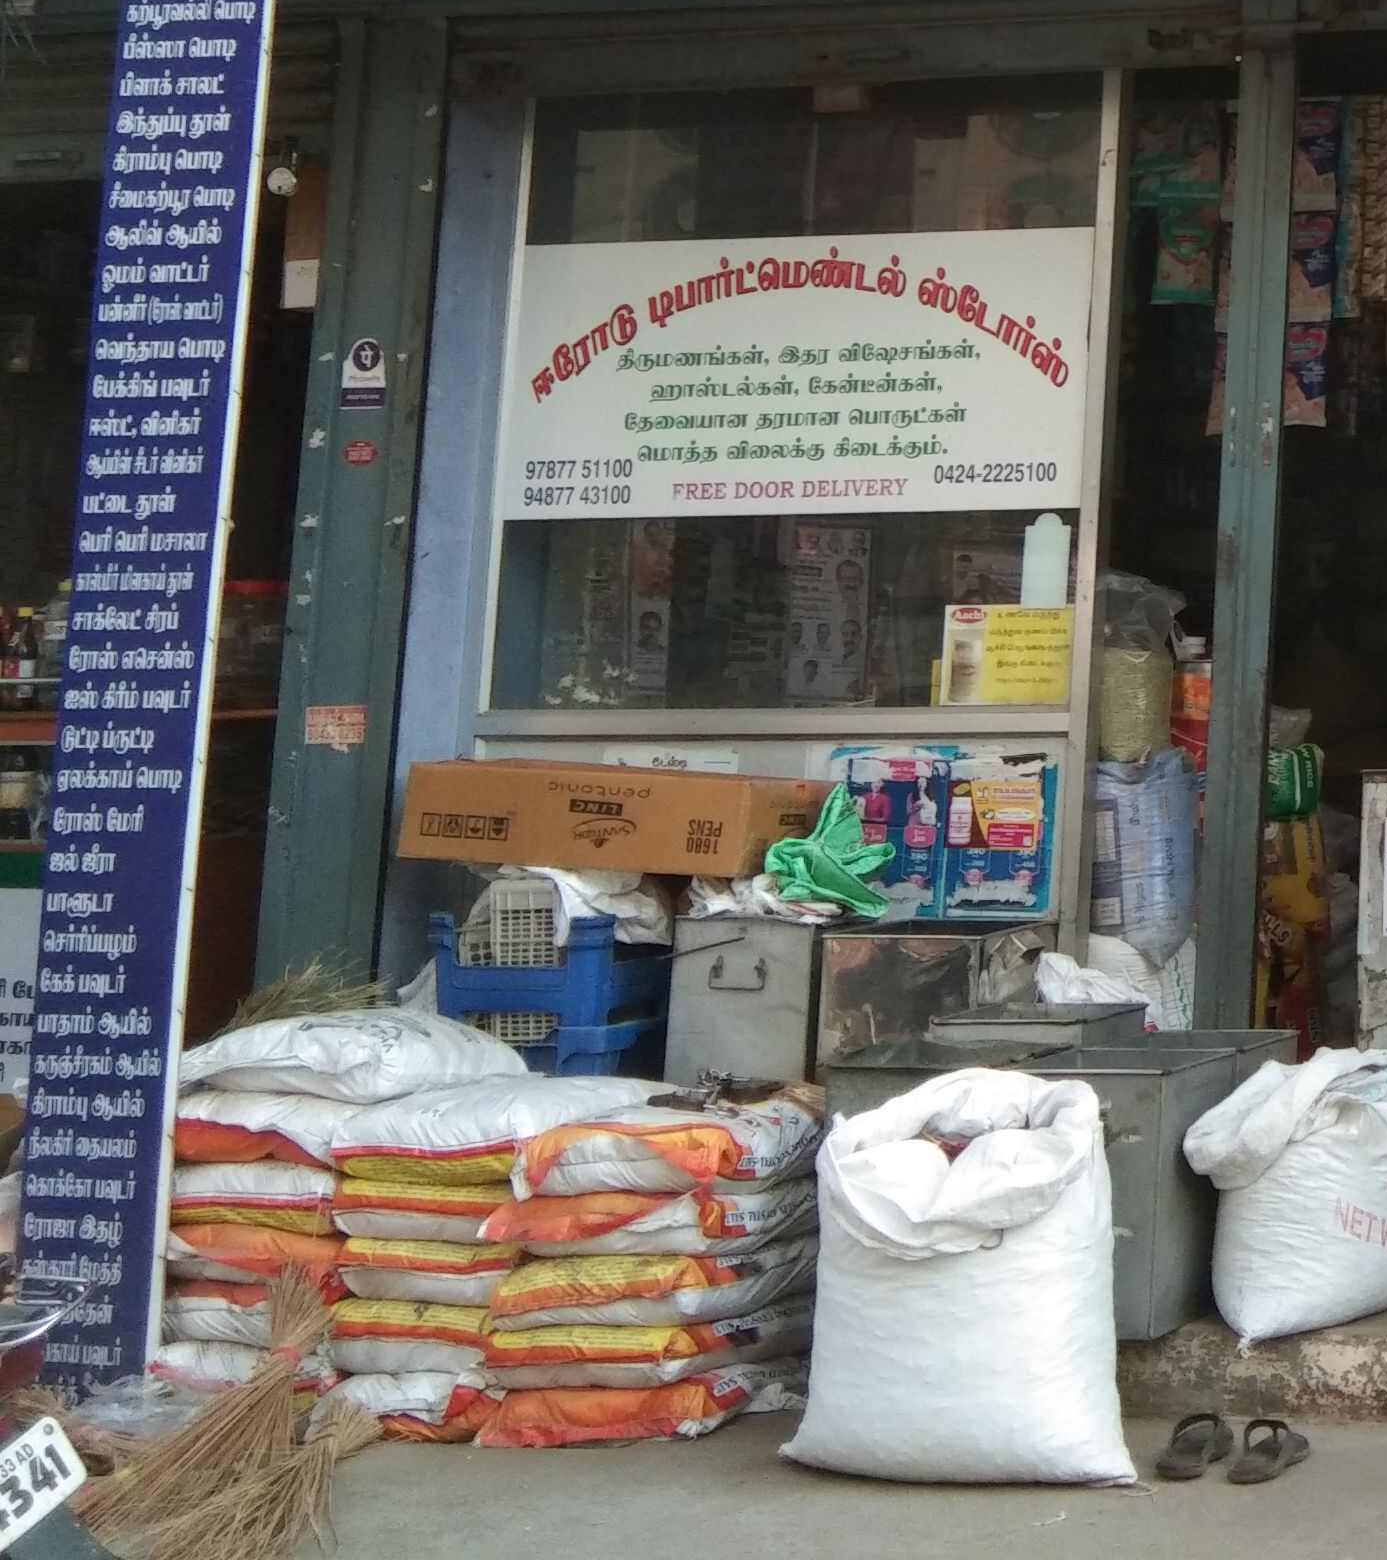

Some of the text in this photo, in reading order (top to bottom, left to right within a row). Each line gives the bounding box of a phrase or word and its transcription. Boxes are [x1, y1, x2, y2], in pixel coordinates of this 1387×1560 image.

[214, 0, 256, 24] பொடி
[189, 36, 236, 62] பொடி
[174, 147, 223, 174] பொடி
[192, 184, 236, 212] பொடி
[532, 246, 1070, 403] ஈரோடு டிபார்ட்மெண்டல் ஸ்டோர்ஸ்
[177, 336, 226, 363] பொடி
[778, 343, 829, 370] இதர
[625, 402, 967, 434] தேவையான தரமான பொருட்கள்
[637, 437, 718, 464] மொத்த
[726, 435, 826, 462] விலைக்கு
[525, 457, 633, 481] 97877 51100
[934, 462, 1057, 485] 0424-2225100
[524, 484, 631, 507] 94877 43100
[671, 476, 908, 502] FREE DOOR DELIVERY
[136, 766, 183, 793] பொடி
[548, 781, 650, 799] pentonic
[53, 803, 103, 835] ரோஸ்
[572, 802, 618, 815] LINC
[688, 819, 723, 837] PENS
[37, 1006, 153, 1039] பாதாம் ஆயில்
[1335, 1197, 1377, 1242] NET
